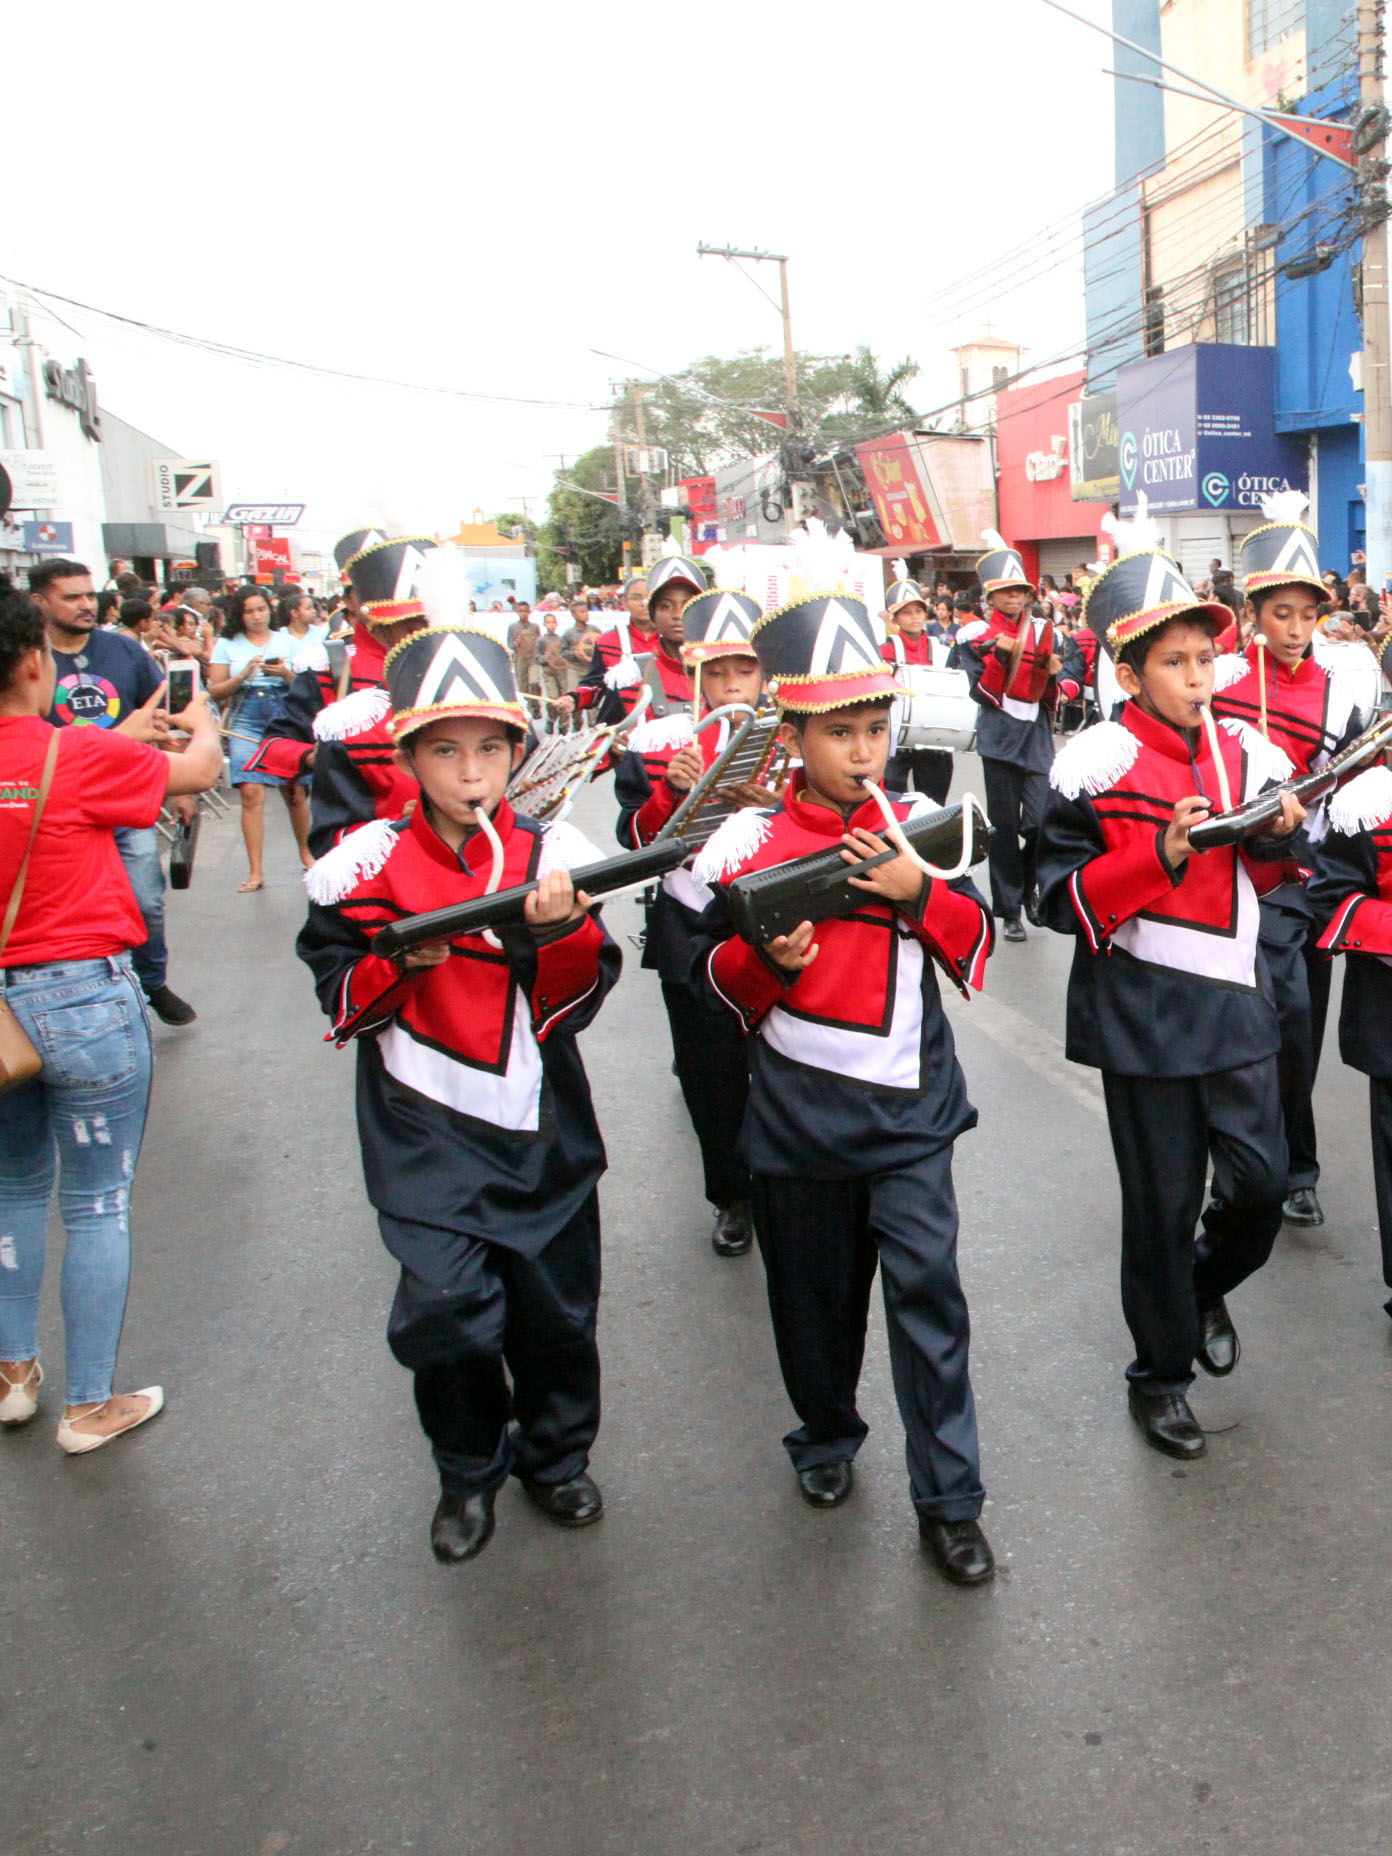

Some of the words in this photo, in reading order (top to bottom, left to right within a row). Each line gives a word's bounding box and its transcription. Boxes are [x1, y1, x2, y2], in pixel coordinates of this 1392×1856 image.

[1142, 426, 1182, 458] ÓTICA
[1143, 453, 1193, 485] CENTER
[1237, 472, 1291, 491] ÓTICA
[159, 464, 172, 508] STUDIO
[71, 694, 108, 710] ETA
